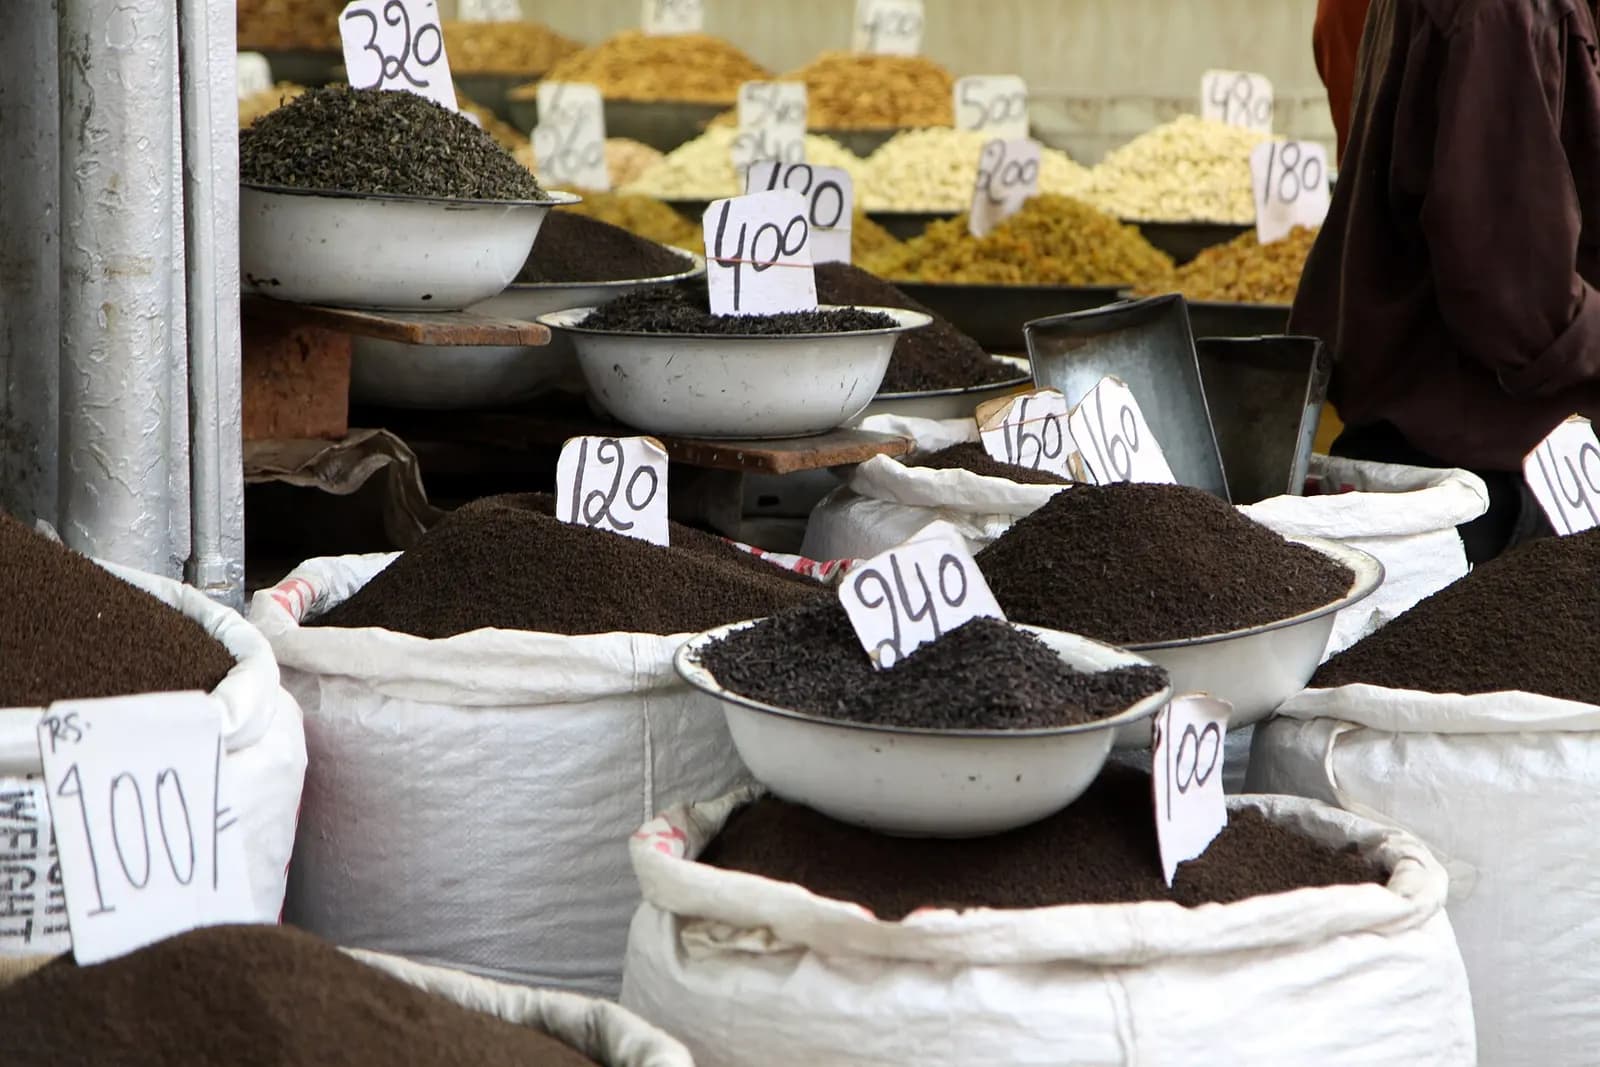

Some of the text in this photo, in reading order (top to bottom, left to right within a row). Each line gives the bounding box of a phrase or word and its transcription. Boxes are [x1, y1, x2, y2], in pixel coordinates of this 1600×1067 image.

[345, 0, 442, 89] 320
[961, 80, 1026, 131] 500
[1211, 73, 1270, 128] 480
[1264, 142, 1321, 204] 180
[714, 200, 808, 311] 400
[1080, 385, 1139, 483] 160
[571, 438, 658, 531] 120
[1167, 702, 1220, 822] 100
